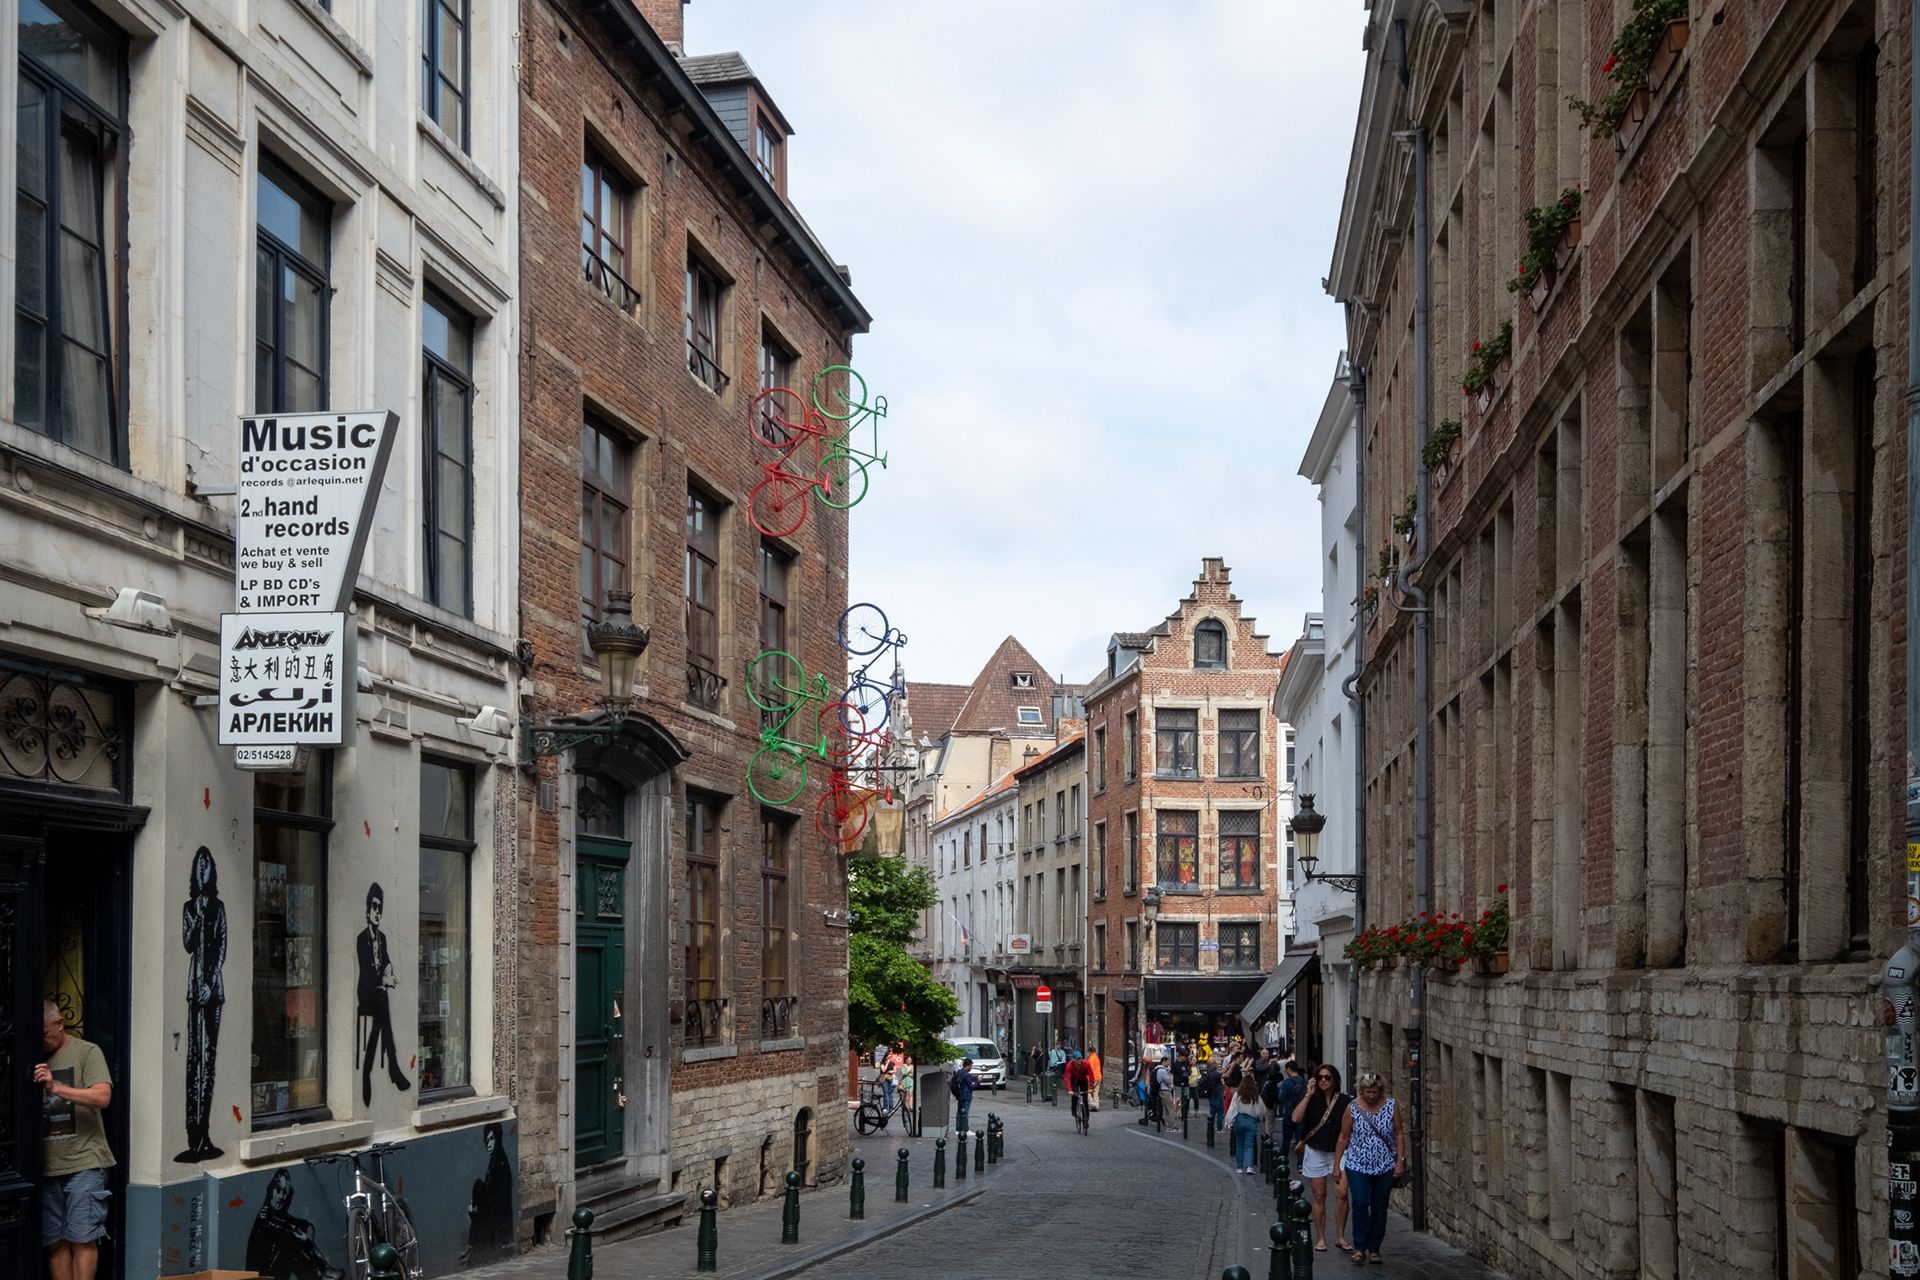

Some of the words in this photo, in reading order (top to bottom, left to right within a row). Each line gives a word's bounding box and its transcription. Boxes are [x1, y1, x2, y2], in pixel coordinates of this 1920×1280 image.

[242, 416, 376, 452] Music
[241, 454, 366, 473] d'occasion
[241, 478, 284, 487] records
[265, 495, 318, 516] hand
[265, 517, 350, 538] records
[241, 546, 276, 557] Achat
[280, 547, 292, 556] et
[296, 546, 330, 556] vente
[241, 560, 258, 569] we
[262, 559, 283, 571] buy
[288, 558, 297, 568] &
[301, 558, 323, 568] sell
[240, 579, 258, 590] LP
[263, 579, 283, 590] BD
[288, 578, 320, 590] CD's
[240, 596, 251, 608] &
[257, 594, 320, 608] IMPORT
[230, 653, 334, 683] 意大利的丑角
[229, 712, 333, 733] АРЛЕКИН
[237, 750, 292, 760] 02/5145428
